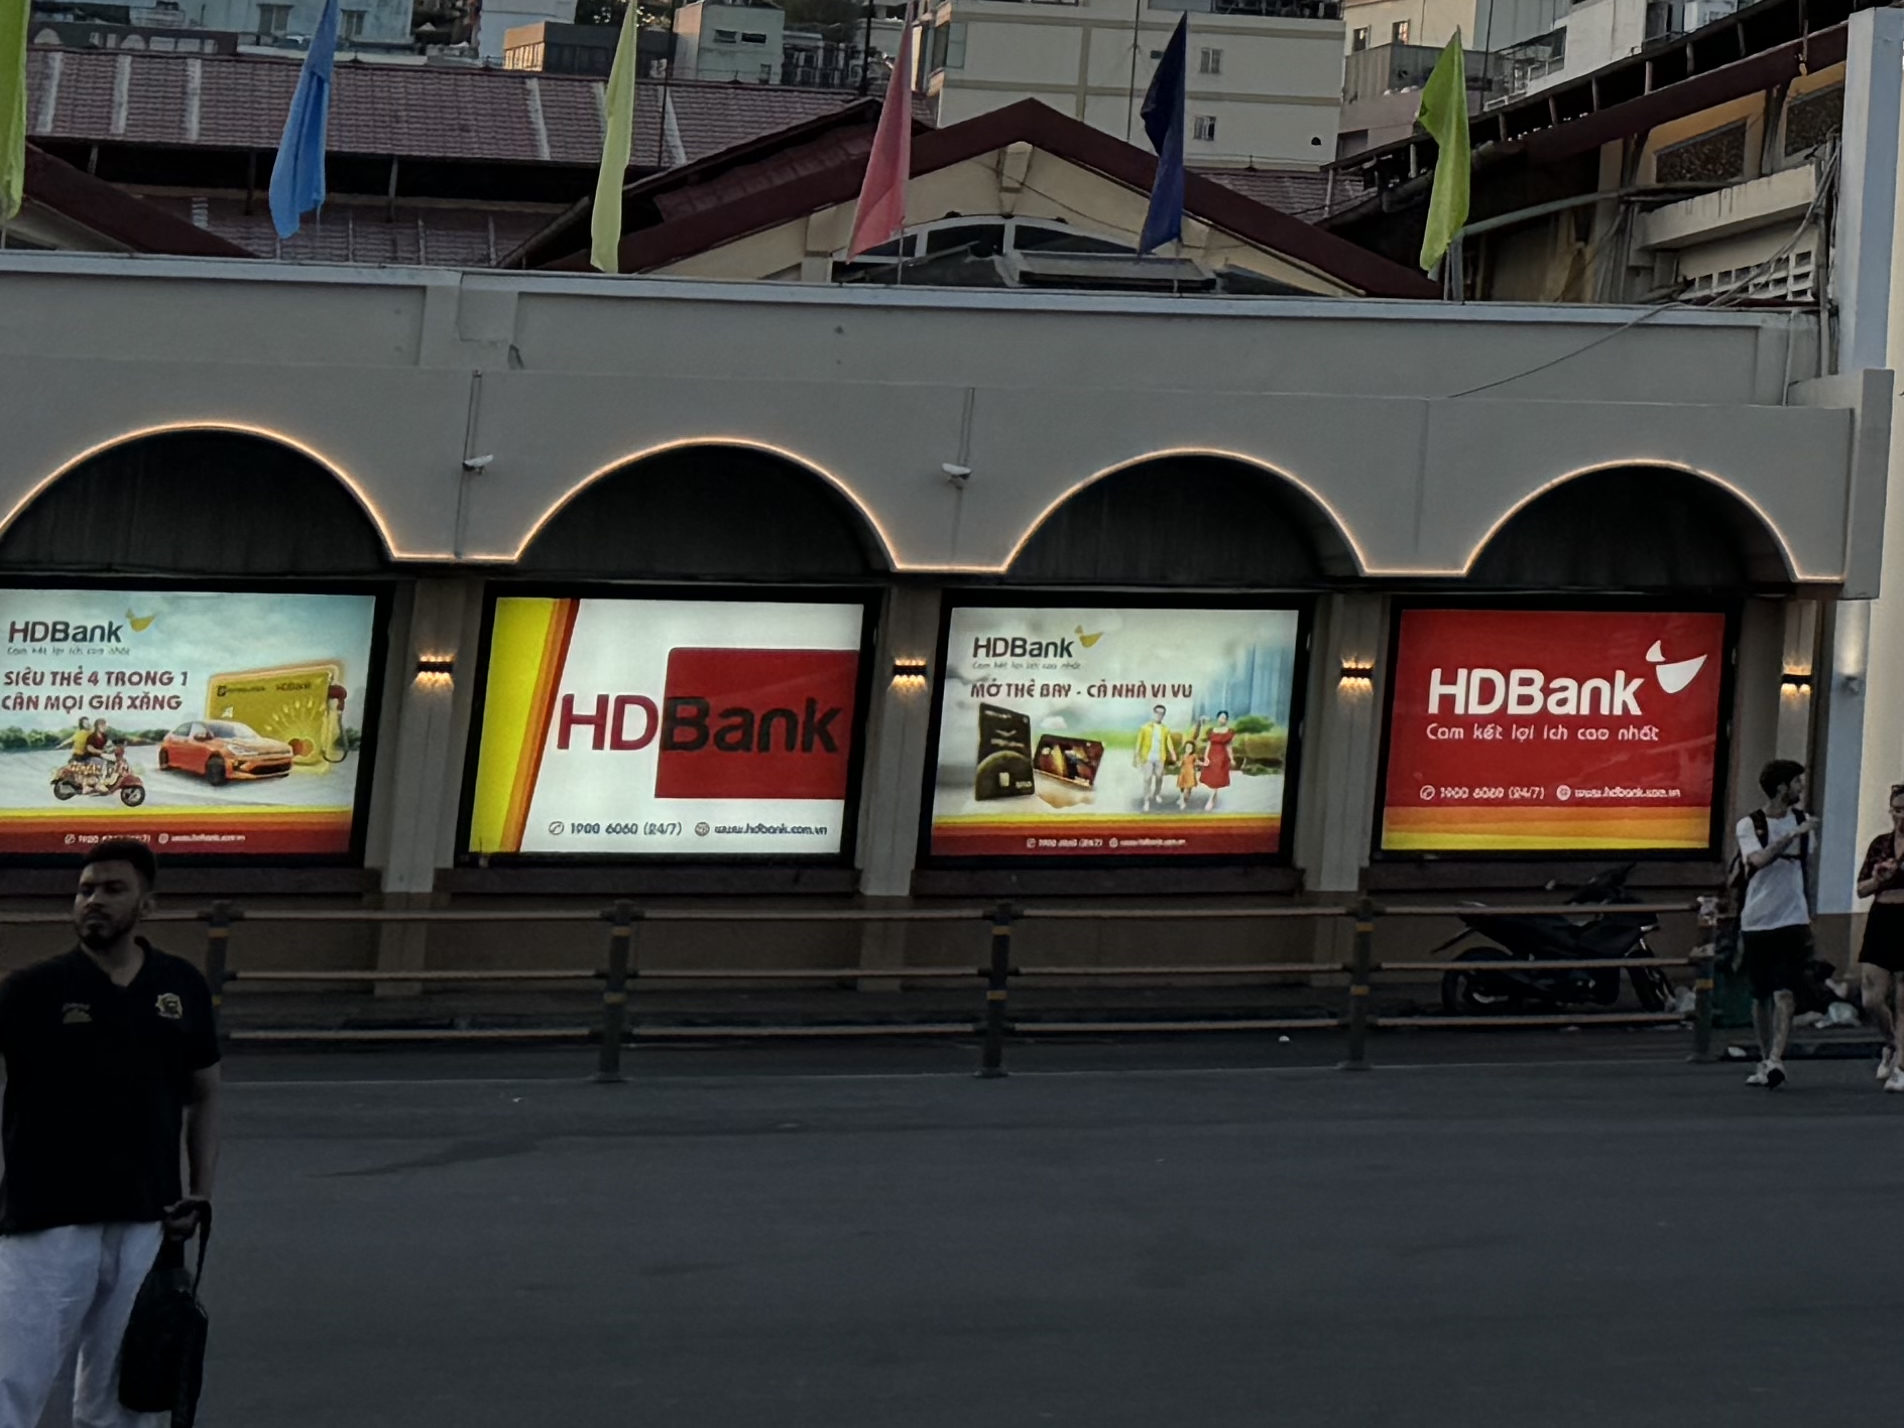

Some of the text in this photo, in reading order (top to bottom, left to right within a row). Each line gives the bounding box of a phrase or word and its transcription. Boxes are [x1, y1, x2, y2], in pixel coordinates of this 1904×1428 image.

[8, 620, 124, 644] HDBank
[973, 636, 1074, 658] HDBank
[87, 671, 100, 686] 4
[105, 670, 175, 687] TRONG
[1040, 683, 1071, 698] BAY
[1151, 683, 1166, 698] VI
[1171, 683, 1193, 698] VU
[1427, 667, 1646, 717] HDBank
[44, 694, 84, 714] MỌI
[88, 691, 124, 711] GIÁ
[556, 692, 842, 754] HDBank
[1426, 722, 1464, 741] Cam
[1577, 726, 1610, 742] cao
